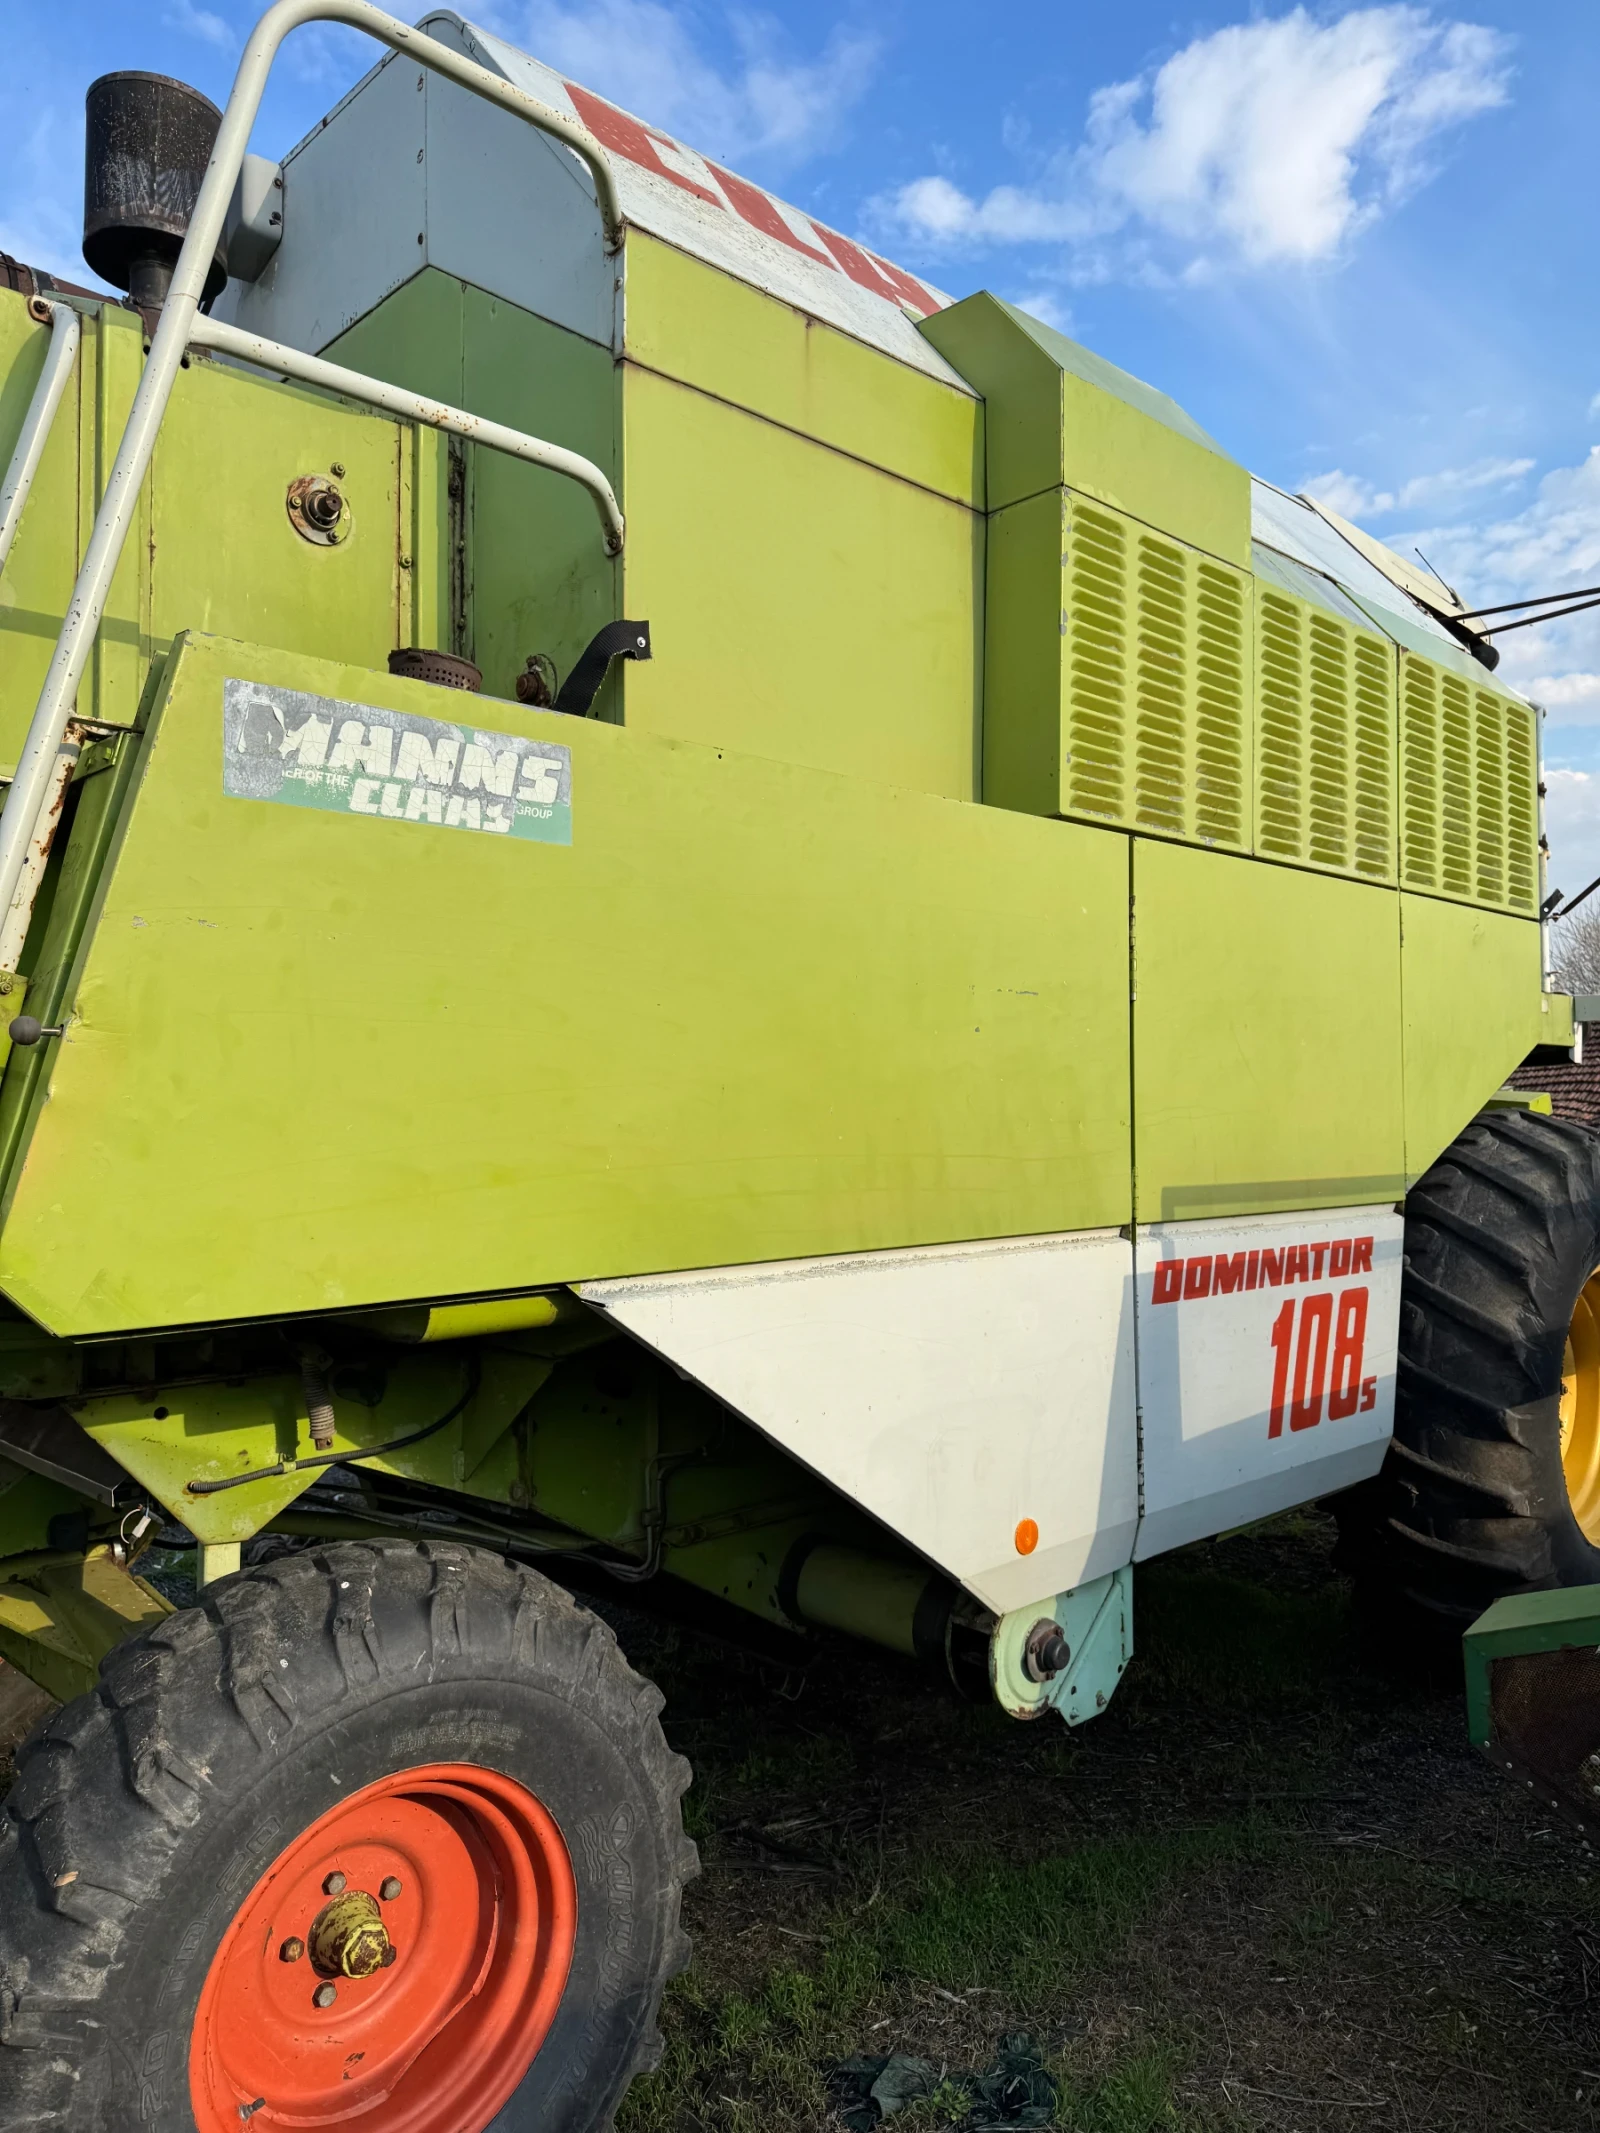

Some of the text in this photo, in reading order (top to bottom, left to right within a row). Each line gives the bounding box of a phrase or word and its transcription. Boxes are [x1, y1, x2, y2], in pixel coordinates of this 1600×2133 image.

[325, 772, 350, 787] THE
[350, 778, 511, 833] CLAAS
[516, 803, 553, 819] GROUP
[1151, 1236, 1374, 1305] DOMINATOR
